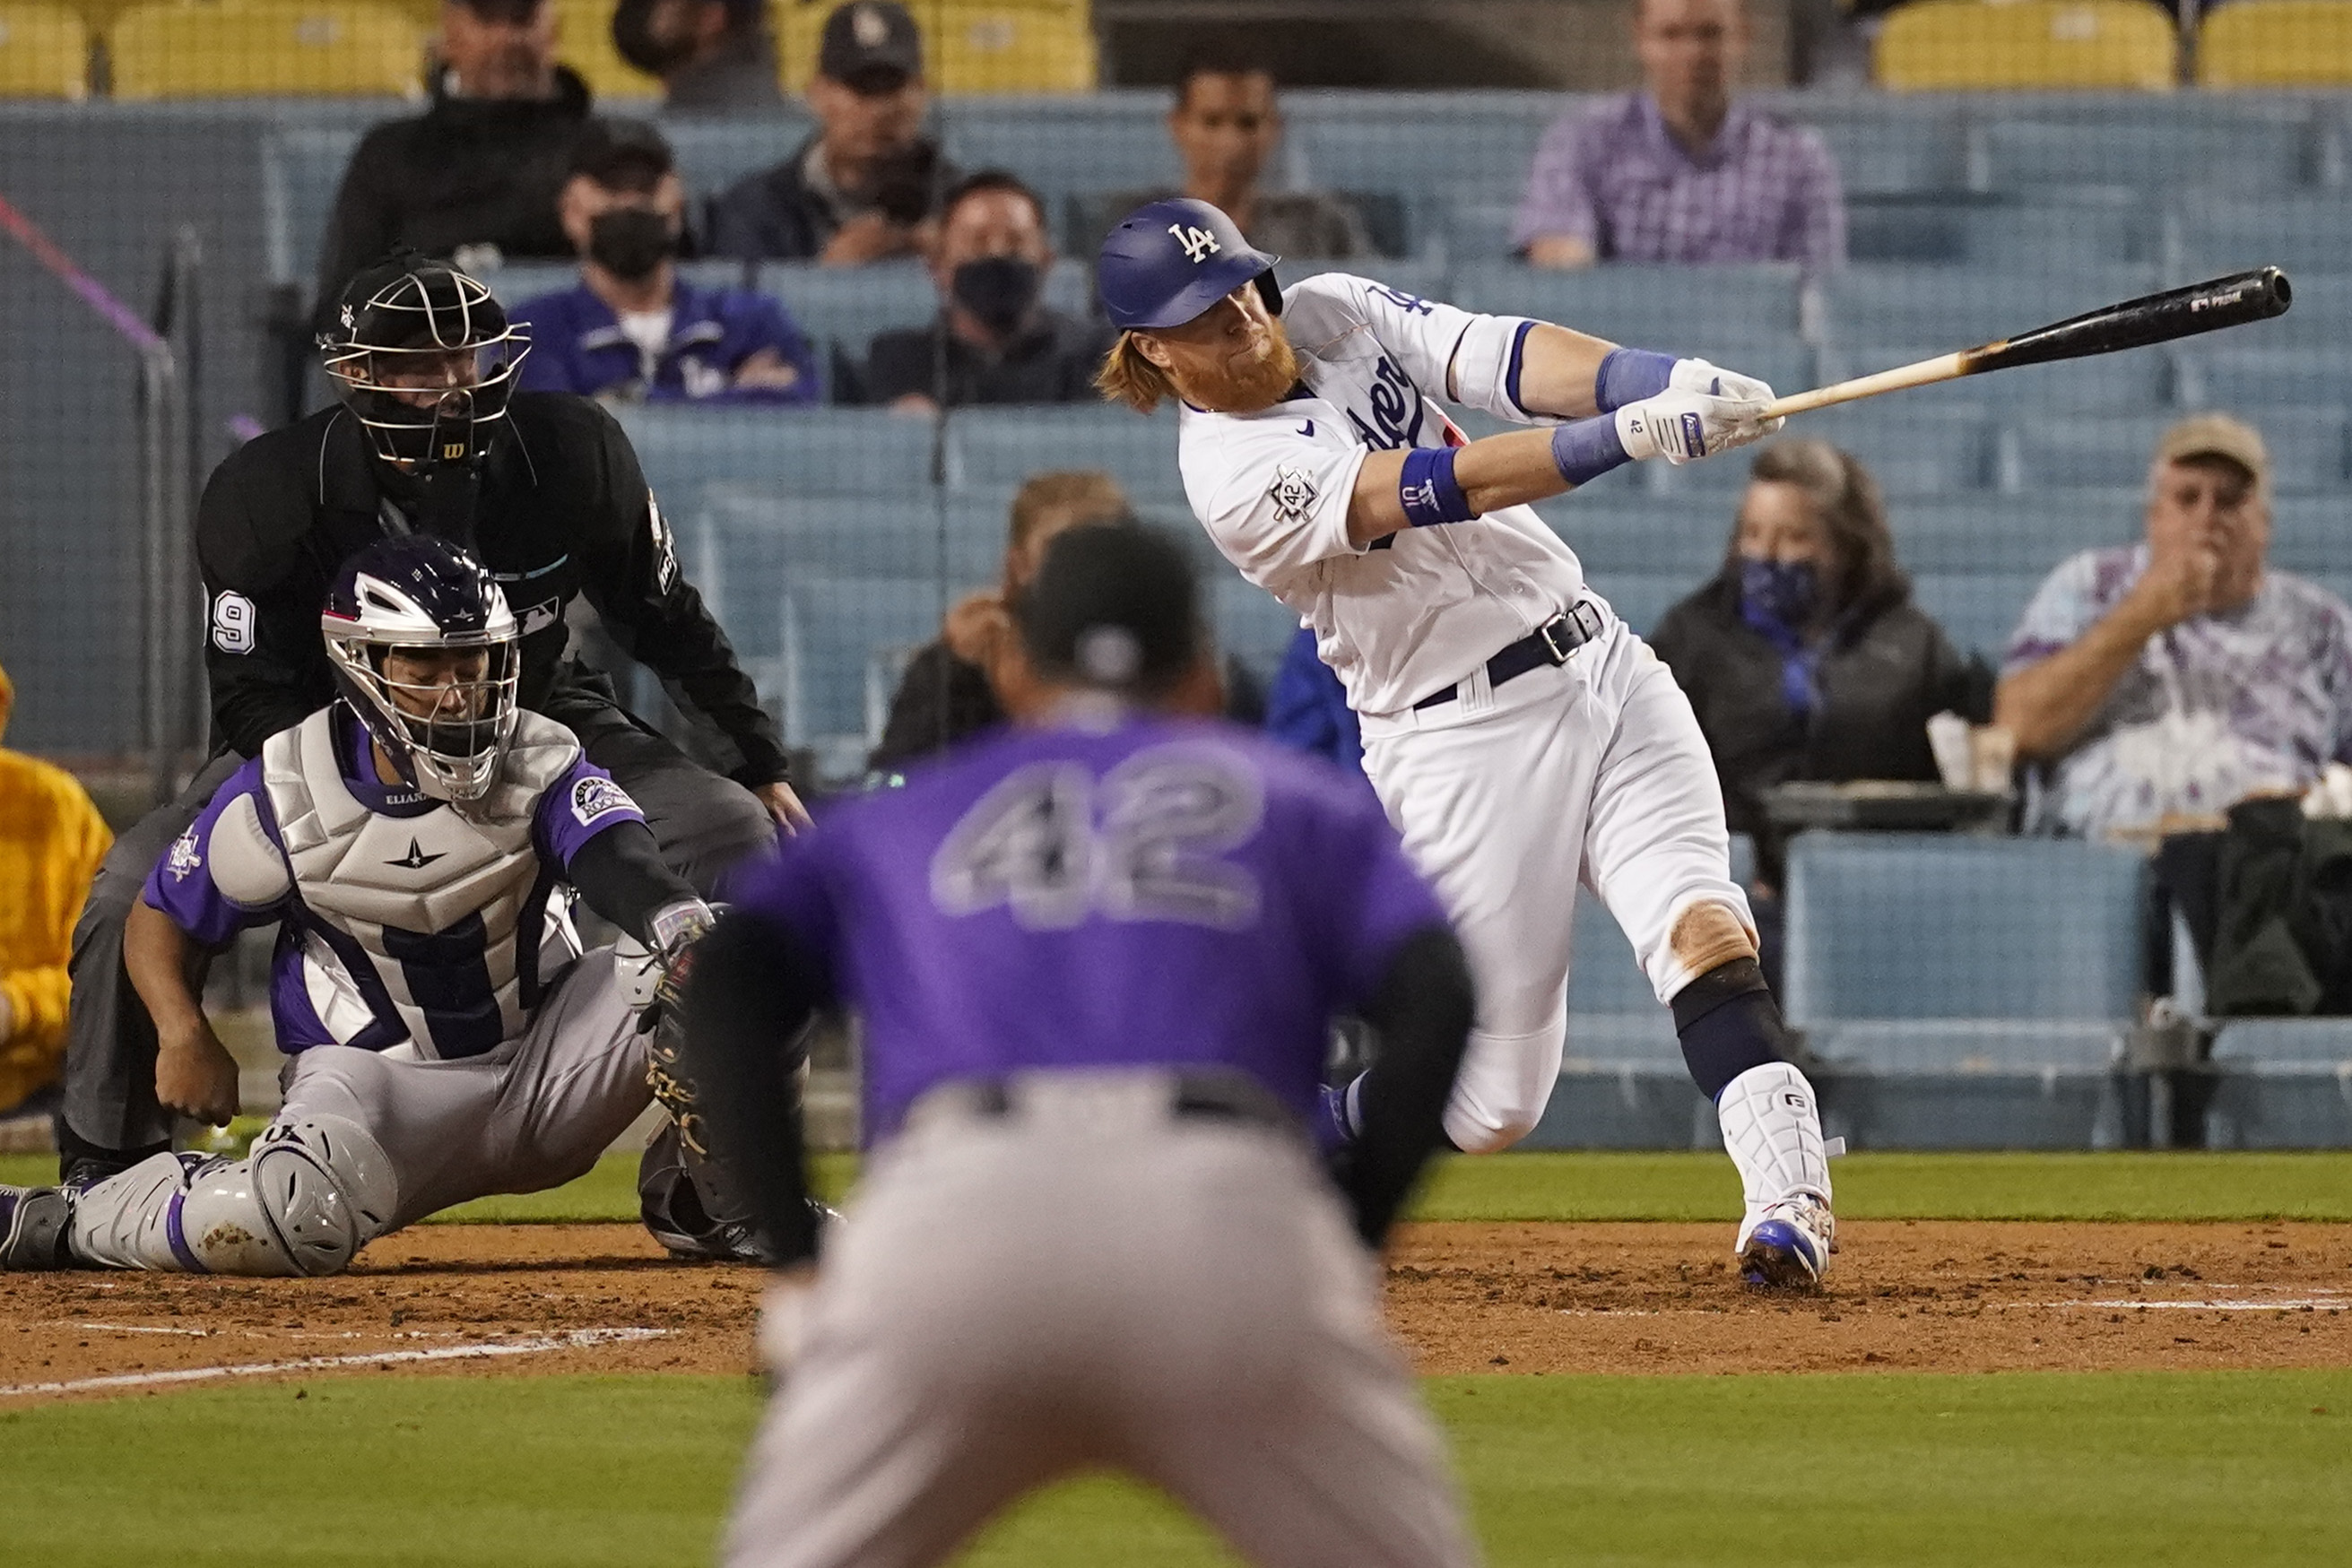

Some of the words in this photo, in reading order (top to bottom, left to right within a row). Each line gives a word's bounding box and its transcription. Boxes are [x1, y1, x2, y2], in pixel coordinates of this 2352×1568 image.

[1167, 223, 1220, 264] LA
[1629, 419, 1644, 435] 42
[1284, 484, 1301, 506] 42
[203, 582, 256, 655] 9
[386, 793, 430, 805] ELIAN
[930, 740, 1263, 932] 42
